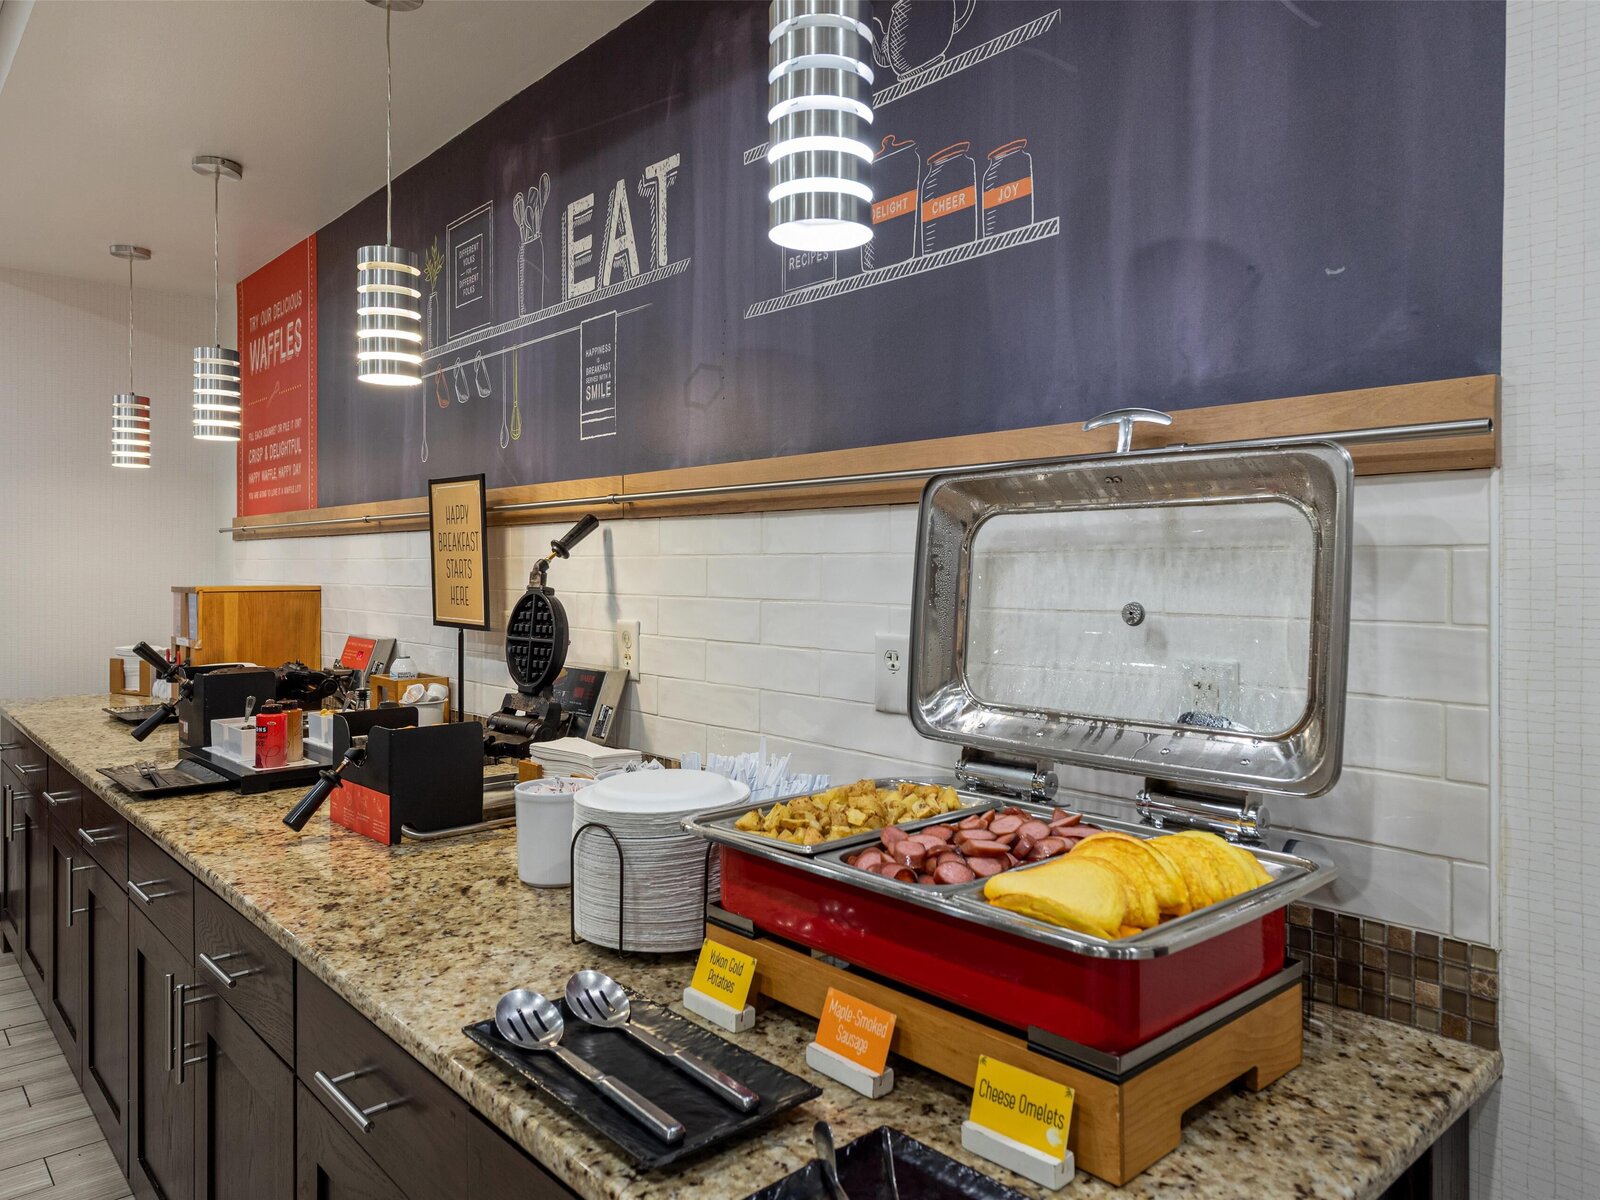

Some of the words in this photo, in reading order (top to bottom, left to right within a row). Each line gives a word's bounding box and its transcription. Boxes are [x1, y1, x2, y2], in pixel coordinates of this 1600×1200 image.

[998, 183, 1019, 203] JOY
[931, 193, 966, 215] CHEER
[563, 153, 681, 301] EAT
[459, 242, 479, 259] DIFFERENT
[789, 250, 829, 270] RECIPES
[459, 272, 479, 289] DIFFERENT
[260, 306, 272, 327] OUR
[272, 289, 302, 320] DELICIOUS
[249, 318, 302, 376] WAFFLES
[585, 343, 611, 357] HAPPINESS
[585, 361, 611, 376] BREAKFAST
[585, 380, 612, 401] SMILE
[248, 447, 263, 464] CRISP
[270, 437, 302, 459] DELIGHTFUL
[248, 471, 260, 484] HAPPY
[278, 464, 292, 479] HAPPY
[445, 504, 469, 525] HAPPY
[438, 531, 479, 552] BREAKFAST
[446, 558, 473, 579] STARTS
[450, 586, 470, 606] HERE
[709, 949, 729, 970] Yukon
[728, 957, 745, 977] Gold
[707, 968, 735, 994] Potatoes
[828, 998, 889, 1039] Maple-Smoked
[835, 1026, 869, 1056] Sausage
[978, 1078, 1016, 1110] Cheese
[1018, 1094, 1065, 1130] Omelets
